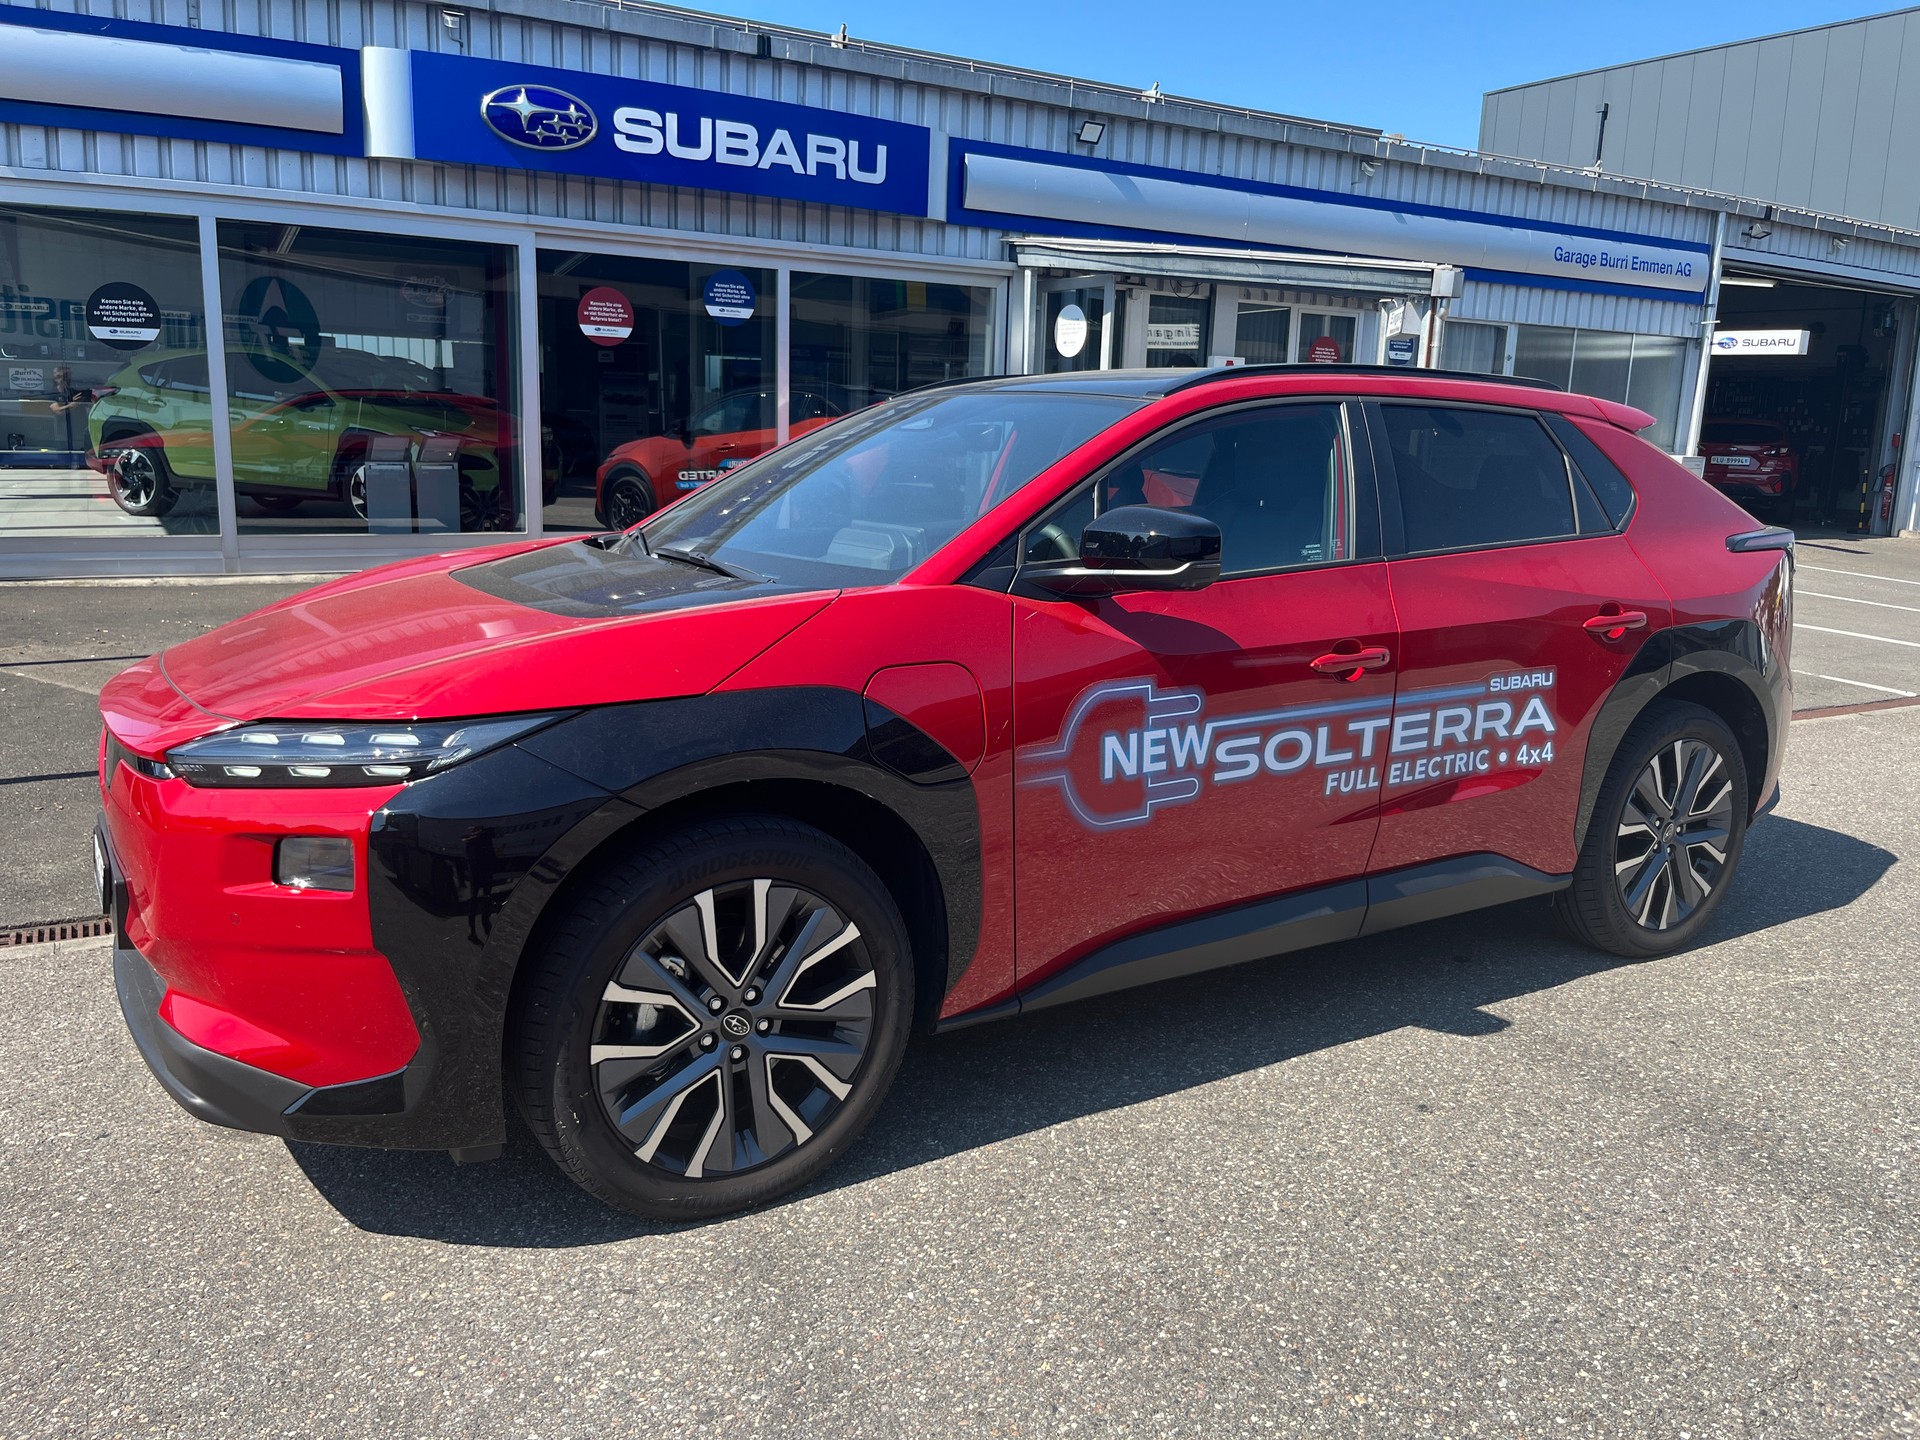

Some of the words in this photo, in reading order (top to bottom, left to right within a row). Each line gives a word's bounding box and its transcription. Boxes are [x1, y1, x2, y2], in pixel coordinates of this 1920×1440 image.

[613, 106, 887, 185] SUBARU
[1553, 246, 1597, 269] Garage
[1600, 252, 1629, 270] Burri
[1631, 256, 1673, 275] Emmen
[1675, 261, 1692, 278] AG
[1741, 337, 1797, 347] SUBARU
[1490, 672, 1554, 693] SUBARU
[1102, 722, 1212, 780] NEW
[1212, 697, 1556, 782] SOLTERRA
[1325, 767, 1379, 796] FULL
[1388, 751, 1490, 786] ELECTRIC
[1516, 740, 1554, 766] 4x4
